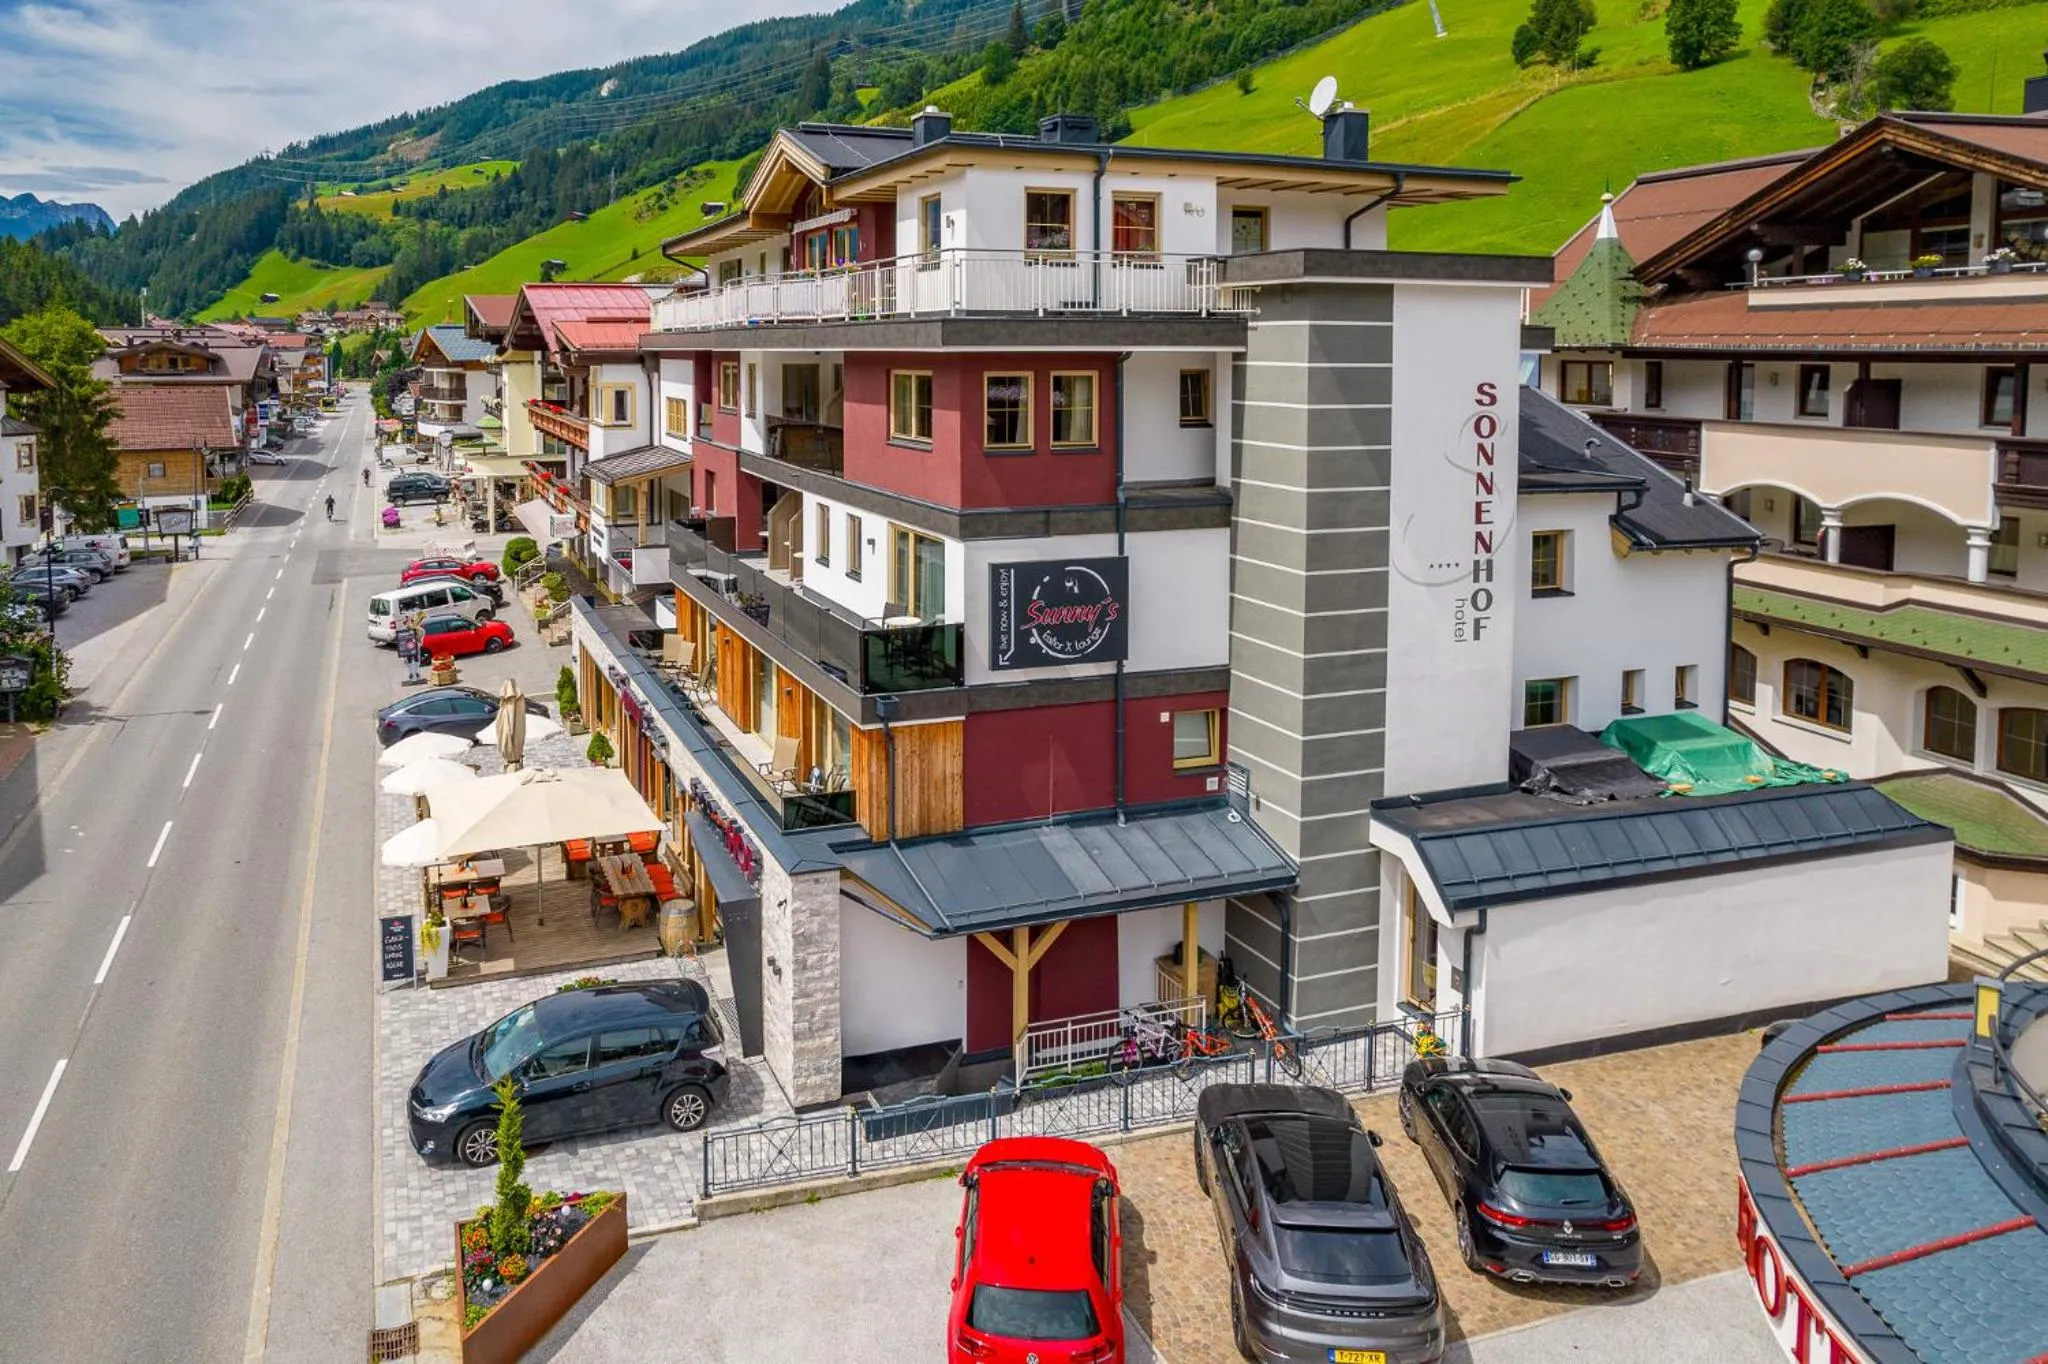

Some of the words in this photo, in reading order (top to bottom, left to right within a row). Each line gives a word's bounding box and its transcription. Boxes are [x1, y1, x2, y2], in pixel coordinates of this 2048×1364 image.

[1470, 382, 1498, 641] SONNENHOF
[999, 599, 1008, 608] &
[1020, 597, 1119, 632] Sunny's
[1000, 610, 1008, 631] now
[1453, 598, 1467, 642] hotel
[999, 633, 1008, 649] live
[1737, 1175, 1864, 1364] HOT
[1339, 1351, 1381, 1362] T-727-XR
